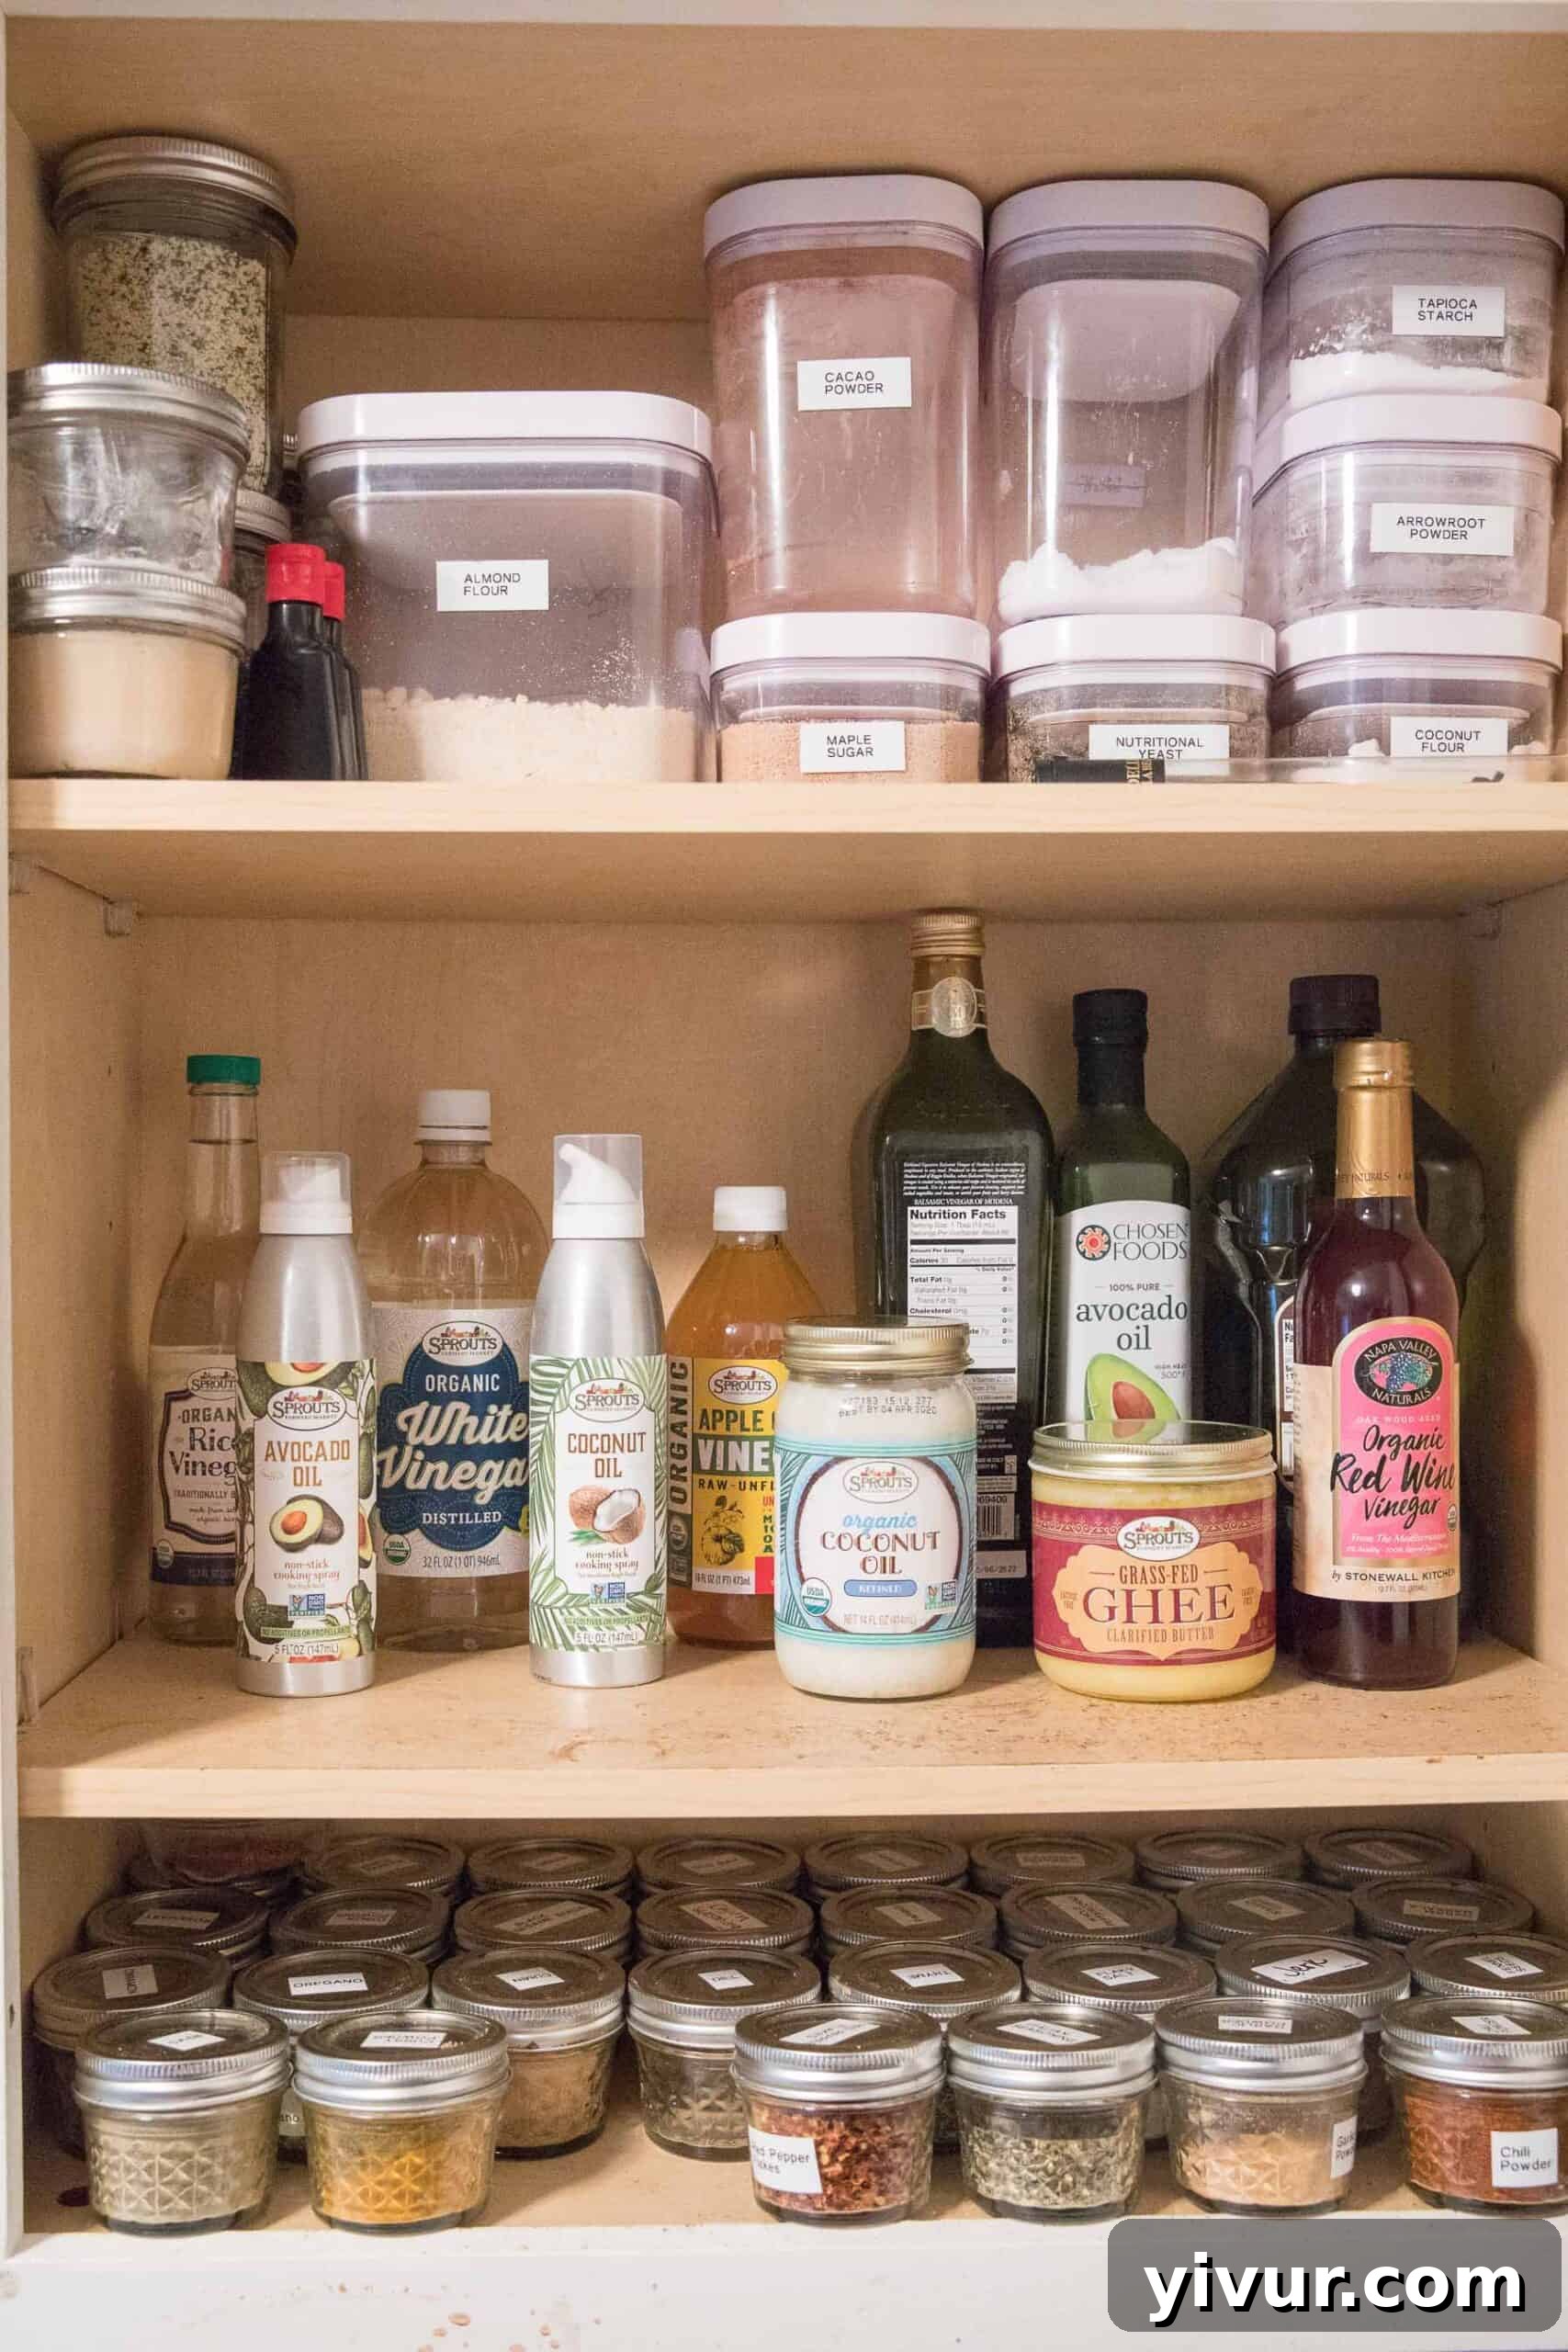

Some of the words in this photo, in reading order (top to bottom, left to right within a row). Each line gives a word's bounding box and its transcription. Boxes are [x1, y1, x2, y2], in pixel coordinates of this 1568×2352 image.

[1418, 298, 1477, 310] TAPIOCA
[1418, 311, 1473, 321] STARCH
[825, 370, 874, 383] CACAO
[825, 382, 884, 395] POWDER
[1396, 516, 1485, 529] ARROWROOT
[1410, 529, 1468, 540] POWDER
[464, 572, 522, 583] ALMOND
[464, 585, 508, 596] FLOUR
[827, 734, 872, 745] MAPLE
[1116, 736, 1205, 748] NUTRITIONAL
[1415, 729, 1482, 741] COCONUT
[828, 746, 874, 758] SUGAR
[1138, 749, 1184, 760] YEAST
[1421, 742, 1464, 752] FLOUR
[909, 1209, 966, 1220] Nutrition
[971, 1209, 1007, 1220] Facts
[1113, 1224, 1190, 1239] CHOSEN
[1113, 1241, 1188, 1261] FOODS
[1110, 1283, 1134, 1292] 100%
[1137, 1283, 1161, 1291] PURE
[1076, 1295, 1188, 1322] avocado
[1117, 1324, 1152, 1351] oil
[429, 1337, 498, 1355] SPROUTS
[1365, 1342, 1396, 1362] NAPA
[1399, 1340, 1437, 1360] VALLEY
[191, 1379, 236, 1391] SPROUT
[425, 1374, 501, 1392] ORGANIC
[714, 1380, 773, 1395] SPROUTS
[575, 1394, 640, 1411] SPROUTS
[1371, 1387, 1431, 1405] NATURALS
[182, 1407, 236, 1424] ORGAN
[272, 1400, 340, 1419] SPROUTS
[397, 1400, 529, 1445] White
[699, 1408, 763, 1432] APPLE
[670, 1362, 688, 1504] ORGANIC
[568, 1432, 647, 1453] COCONUT
[1363, 1424, 1446, 1461] Organic
[265, 1440, 350, 1462] AVOCADO
[697, 1439, 770, 1472] VINE
[169, 1451, 236, 1486] Vineg
[378, 1444, 529, 1506] Vinega
[594, 1457, 623, 1477] OIL
[1330, 1452, 1392, 1494] Red
[1401, 1451, 1455, 1495] Wine
[293, 1466, 322, 1487] OIL
[698, 1478, 774, 1491] RAW-UNFI
[850, 1476, 913, 1492] SPROUTS
[423, 1511, 502, 1525] DISTILLED
[1364, 1495, 1441, 1531] Vinegar
[842, 1511, 919, 1533] organic
[821, 1531, 942, 1553] COCONUT
[1123, 1532, 1194, 1550] SPROUTS
[423, 1555, 432, 1567] 32
[587, 1548, 629, 1559] non-stick
[285, 1558, 330, 1569] non-stick
[575, 1559, 612, 1572] cooking
[614, 1560, 639, 1573] spray
[860, 1555, 903, 1575] OIL
[313, 1571, 340, 1583] spray
[1120, 1564, 1199, 1585] GRASS-FED
[1331, 1569, 1341, 1582] by
[1345, 1571, 1419, 1582] STONEWALL
[1083, 1583, 1235, 1625] GHEE
[575, 1631, 581, 1642] 5
[583, 1632, 592, 1643] FL
[594, 1632, 605, 1644] OZ
[1107, 1628, 1168, 1643] CLARIFIED
[1171, 1625, 1214, 1642] BUTTER
[275, 1645, 280, 1655] 5
[294, 1645, 305, 1655] OZ
[307, 1643, 339, 1656] (147mL)
[770, 2148, 810, 2165] Pepper
[1500, 2145, 1531, 2158] Chili
[1500, 2158, 1551, 2172] Powder
